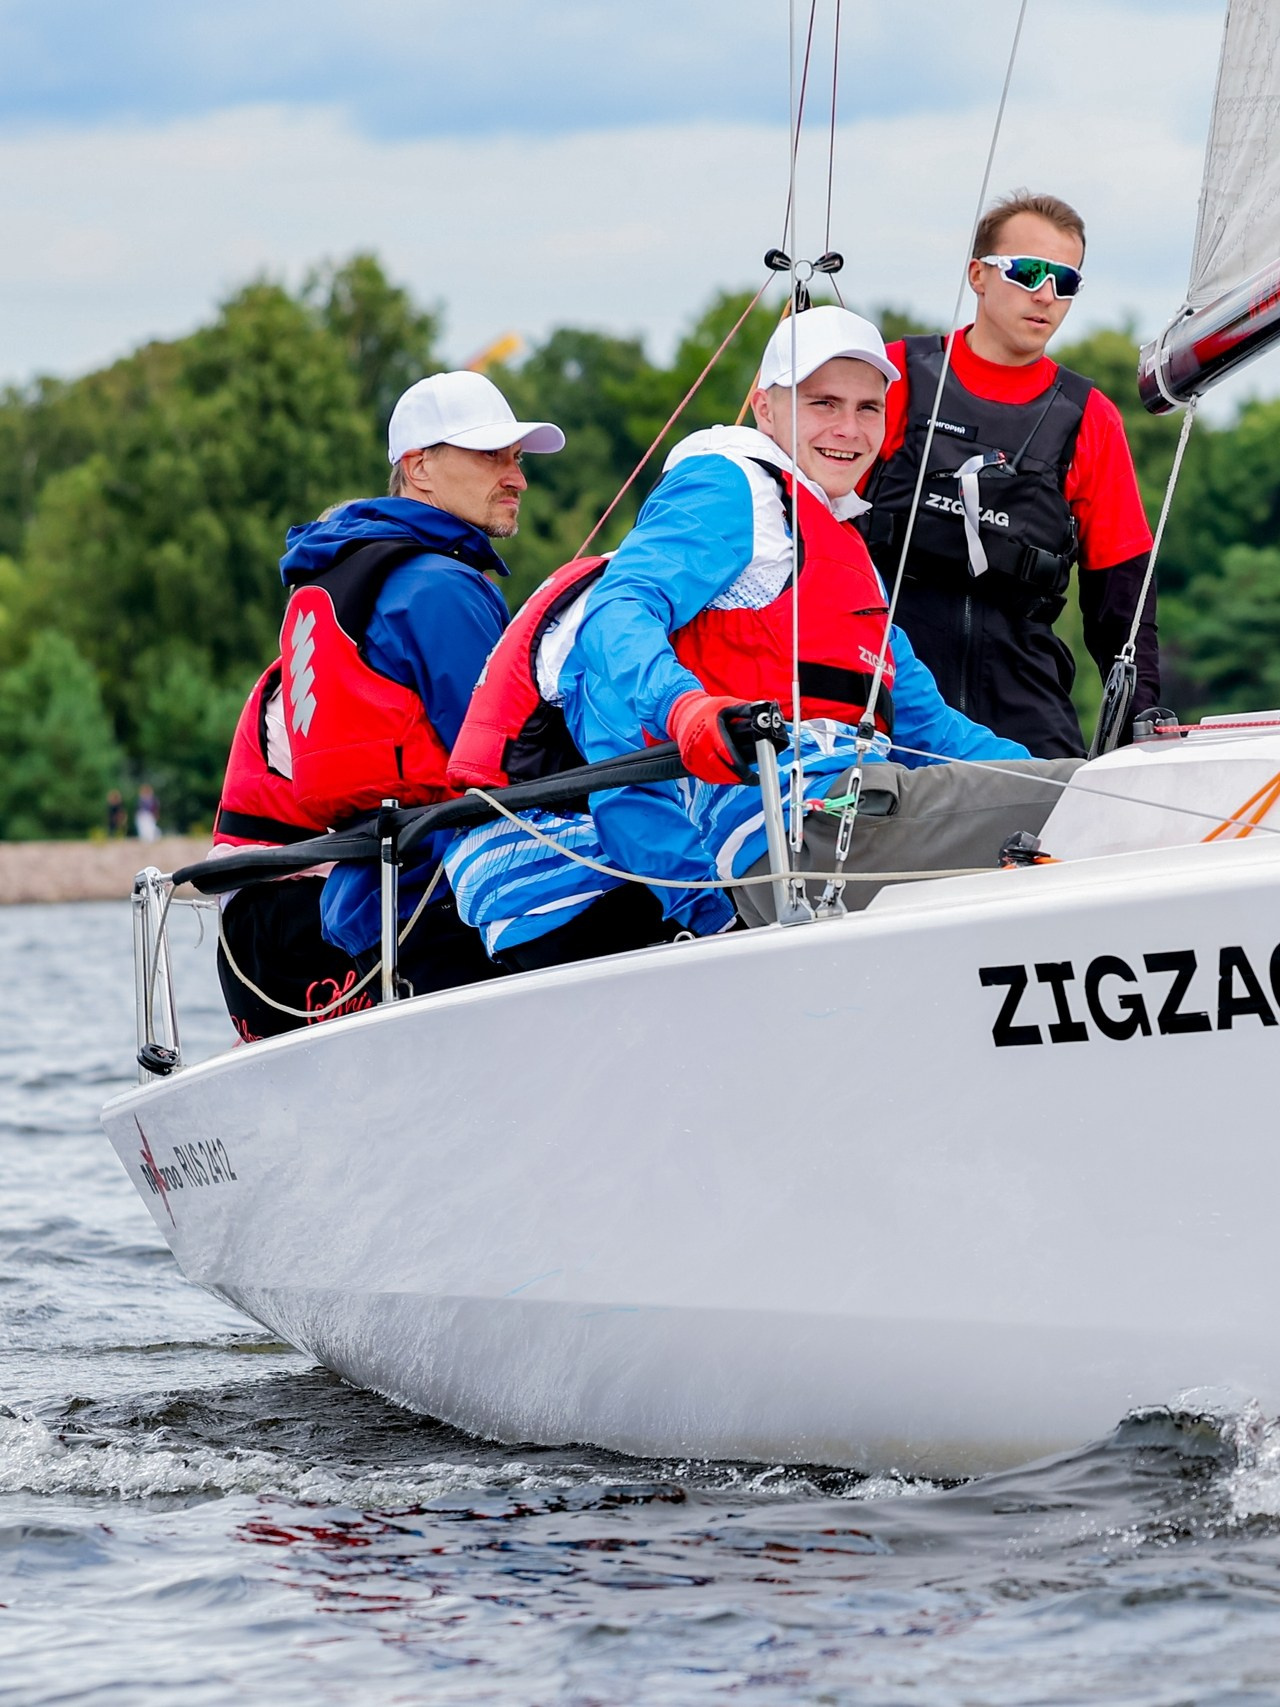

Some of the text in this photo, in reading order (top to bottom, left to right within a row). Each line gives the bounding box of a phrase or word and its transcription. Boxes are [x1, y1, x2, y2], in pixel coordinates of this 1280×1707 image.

[926, 418, 966, 434] ГИГОРИЙ
[173, 1143, 211, 1188] RUS
[198, 1137, 238, 1184] 2412
